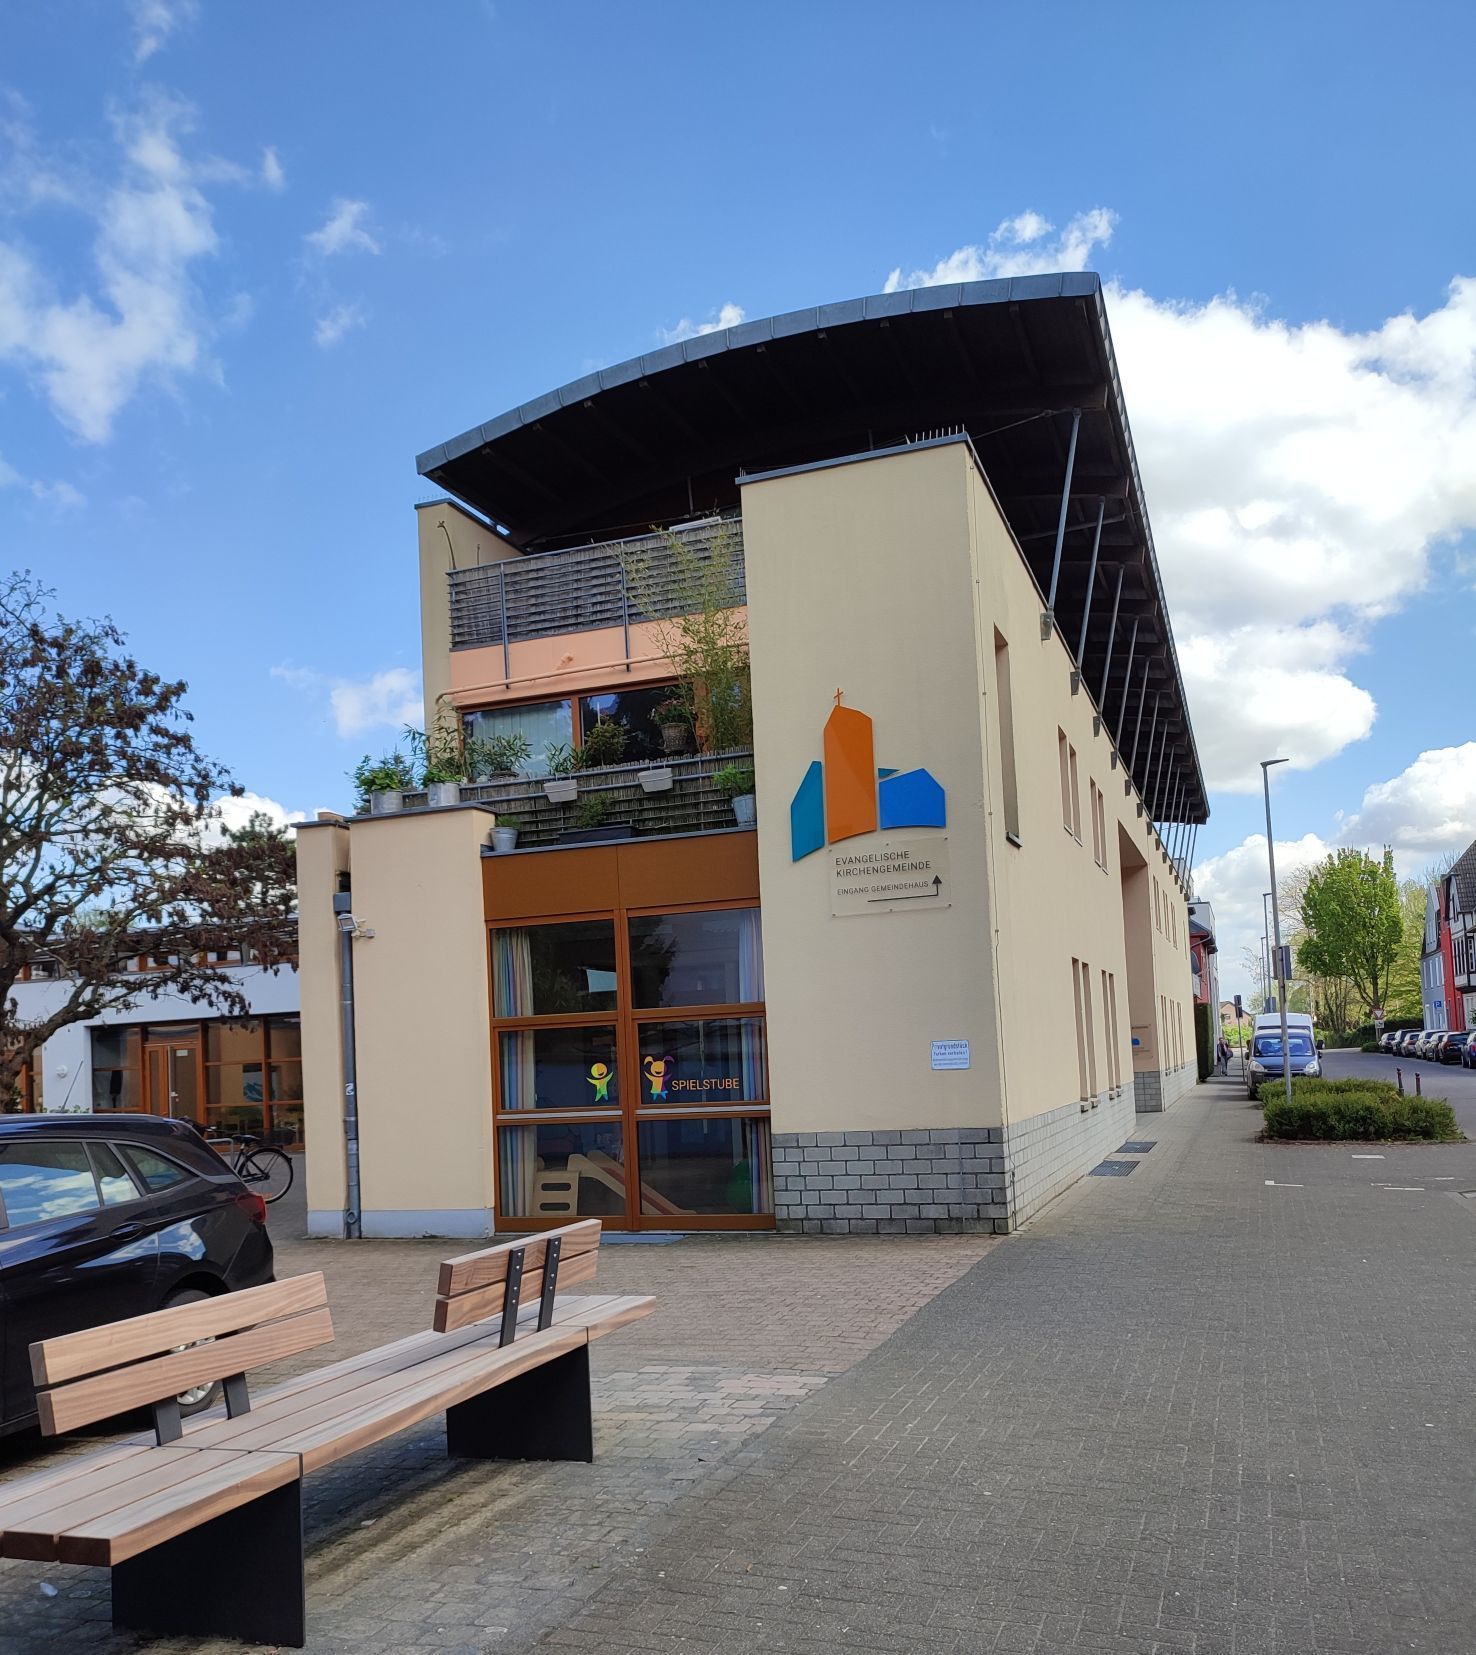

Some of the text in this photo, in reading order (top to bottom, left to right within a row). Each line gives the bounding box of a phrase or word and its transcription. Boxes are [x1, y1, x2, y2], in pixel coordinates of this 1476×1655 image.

[836, 850, 910, 865] EVANGELISCHE
[836, 860, 931, 878] KIRCHENGEMEINDE
[837, 880, 929, 896] EINGANG GEMEINDEHAUS
[672, 1078, 740, 1090] SPIELSTUBE
